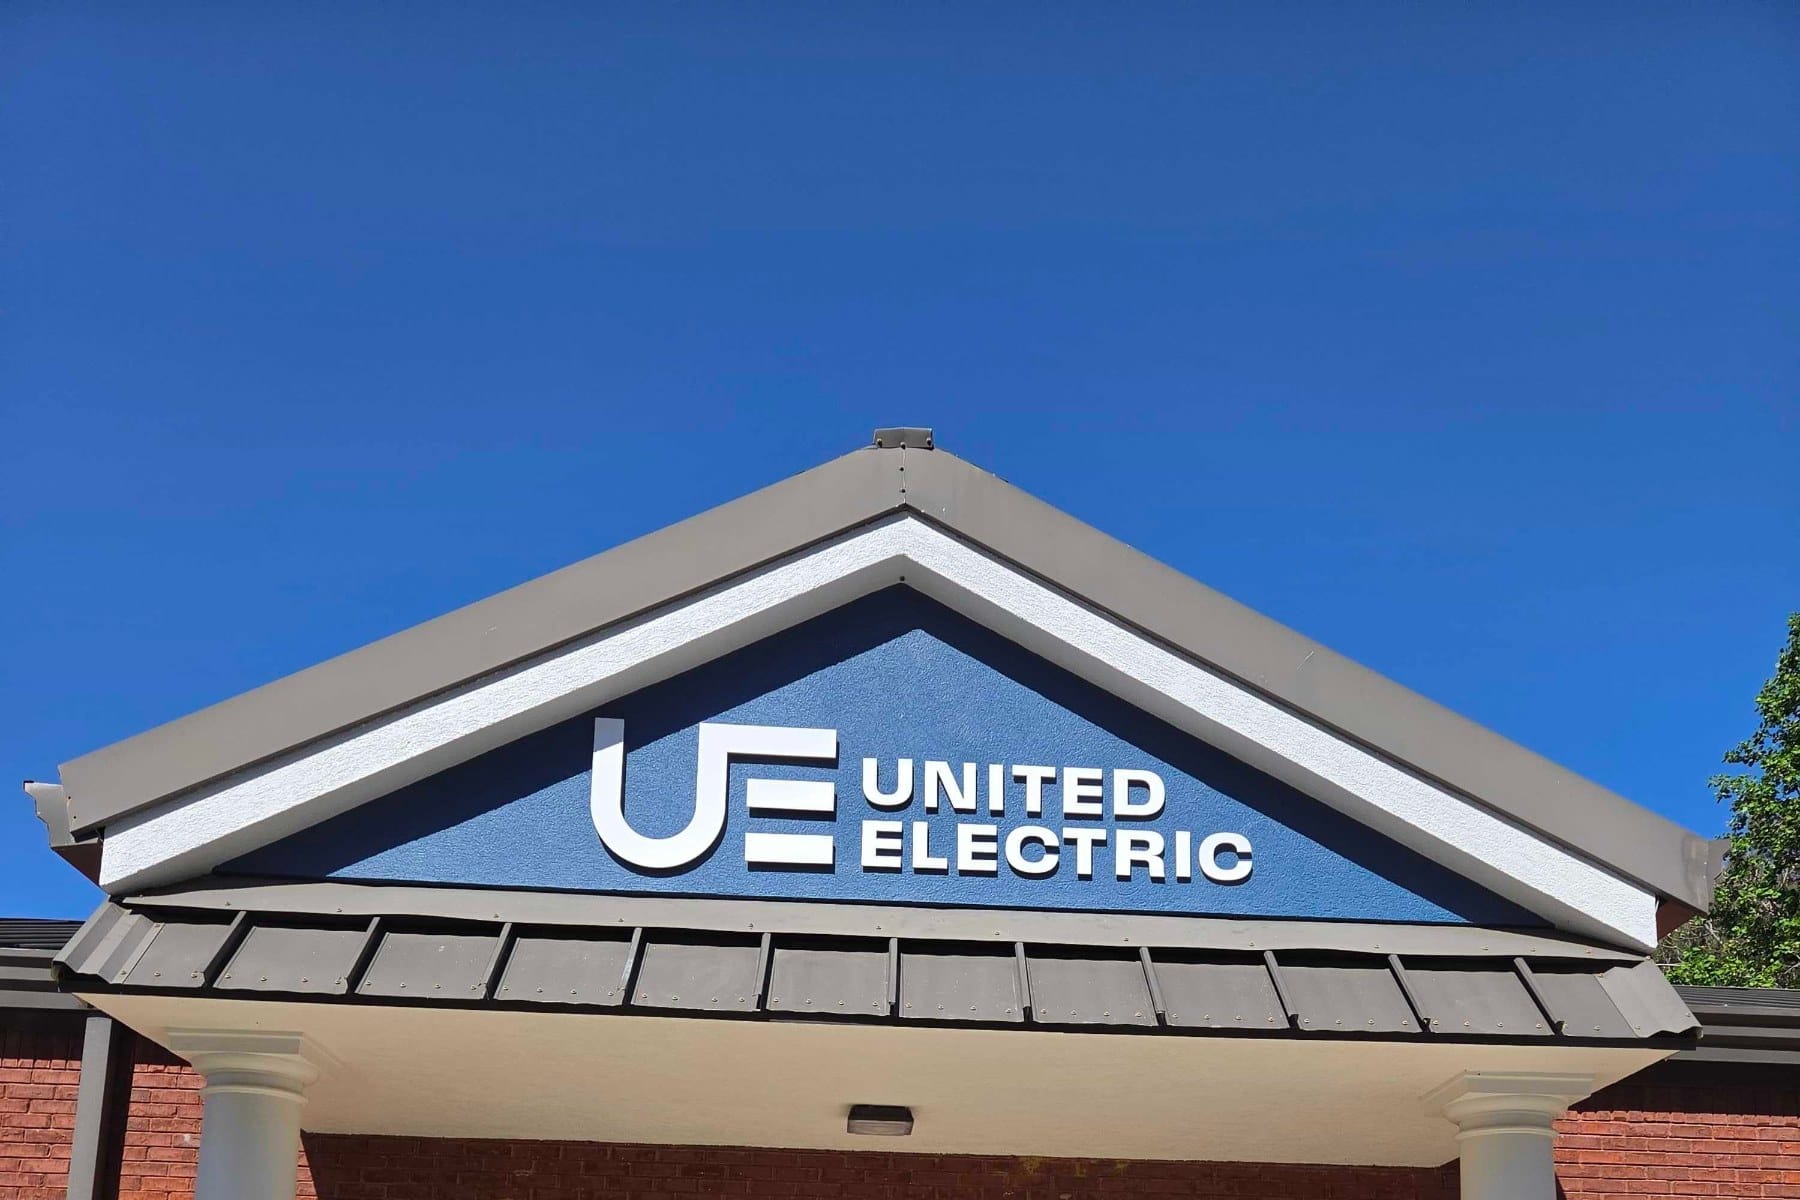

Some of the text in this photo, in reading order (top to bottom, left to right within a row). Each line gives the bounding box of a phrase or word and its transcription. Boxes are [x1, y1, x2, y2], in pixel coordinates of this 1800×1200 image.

[590, 717, 838, 869] UE
[862, 757, 1166, 816] UNITED
[860, 820, 1254, 882] ELECTRIC
